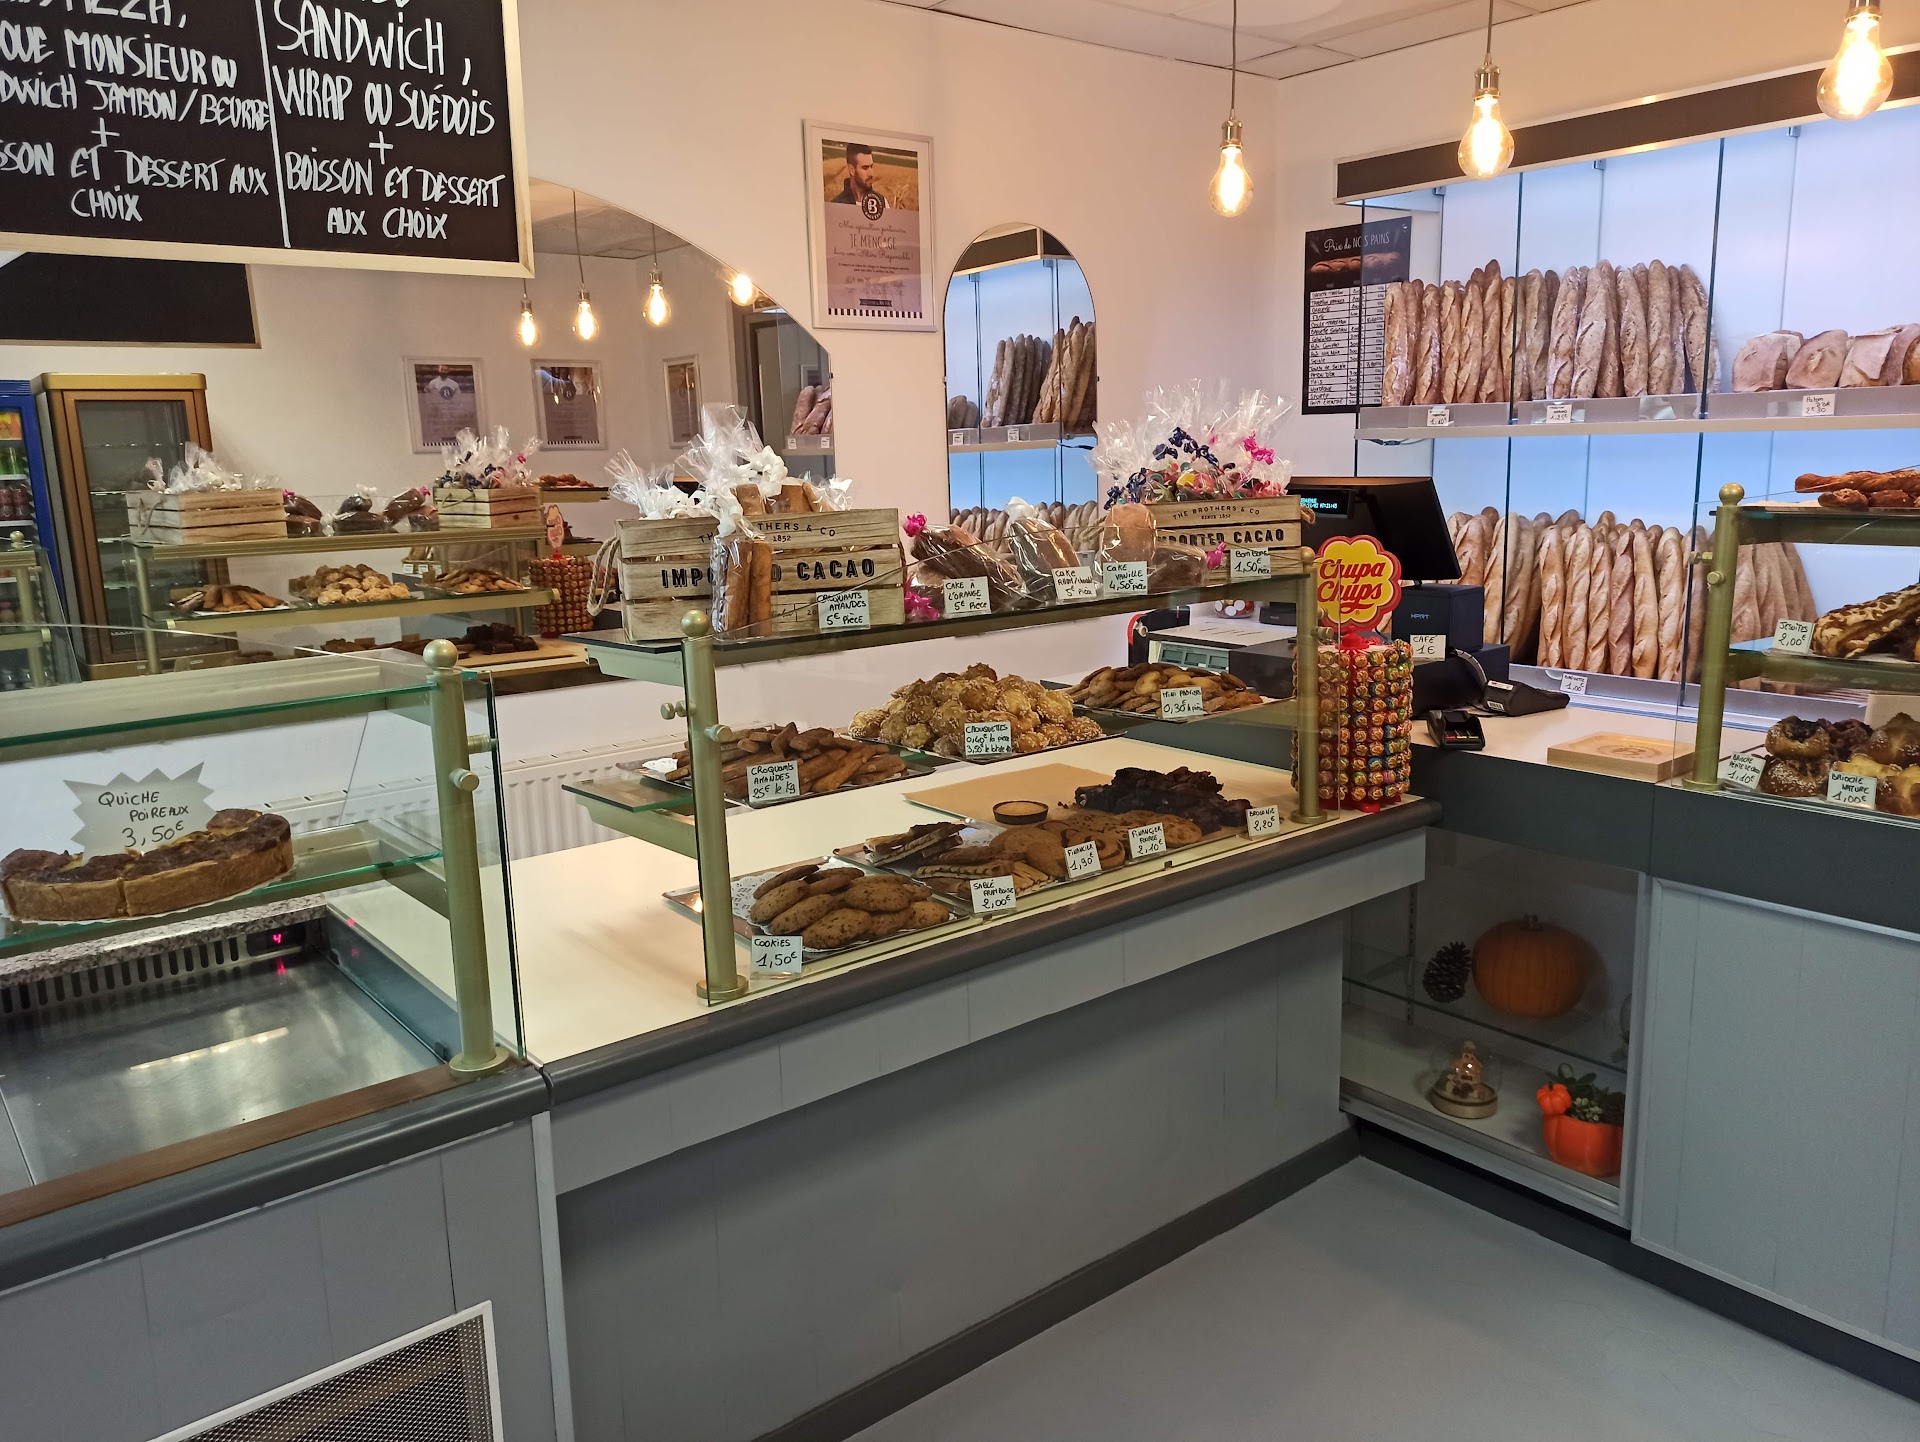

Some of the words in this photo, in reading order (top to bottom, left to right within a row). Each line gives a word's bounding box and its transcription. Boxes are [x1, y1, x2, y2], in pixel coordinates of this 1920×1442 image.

[212, 55, 237, 88] OU
[272, 65, 352, 120] WRAP
[364, 82, 392, 125] OU
[71, 144, 103, 180] ET
[114, 150, 226, 191] DESSERT
[229, 163, 269, 195] AUX
[384, 166, 413, 198] ET
[415, 168, 506, 207] DESSERT
[327, 207, 367, 235] AUX
[850, 234, 857, 248] JE
[1324, 238, 1343, 252] Prix
[1344, 238, 1352, 250] de
[1370, 232, 1390, 246] PAINS
[1173, 511, 1188, 520] THE
[1192, 505, 1237, 514] BROTHERS
[820, 527, 836, 537] CO
[1233, 529, 1284, 543] CACAO
[797, 558, 876, 582] CACAO
[1320, 559, 1386, 584] Chupa
[946, 581, 965, 590] CAKE
[948, 590, 981, 600] L'ORANGE
[1317, 580, 1382, 614] Chups
[830, 601, 866, 611] AMANDES
[954, 601, 965, 610] 5€
[826, 612, 840, 626] 5€
[1412, 635, 1438, 643] CAFÉ
[1778, 632, 1807, 646] 2,00€
[1566, 682, 1584, 691] 1,00€
[754, 772, 790, 784] AMANDES
[752, 785, 770, 799] 25€
[1842, 784, 1869, 794] NATURE
[1831, 791, 1867, 804] 1,00€
[1253, 815, 1275, 831] 2,20€
[122, 820, 184, 848] 3,50€
[1131, 826, 1162, 838] FINANCIER
[1067, 843, 1094, 857] FINANCIER
[1069, 852, 1094, 870] 1,90€
[973, 879, 995, 889] SABLÉ
[982, 894, 1011, 909] 2,00€
[272, 934, 282, 943] 4
[756, 951, 797, 968] 1,50€
